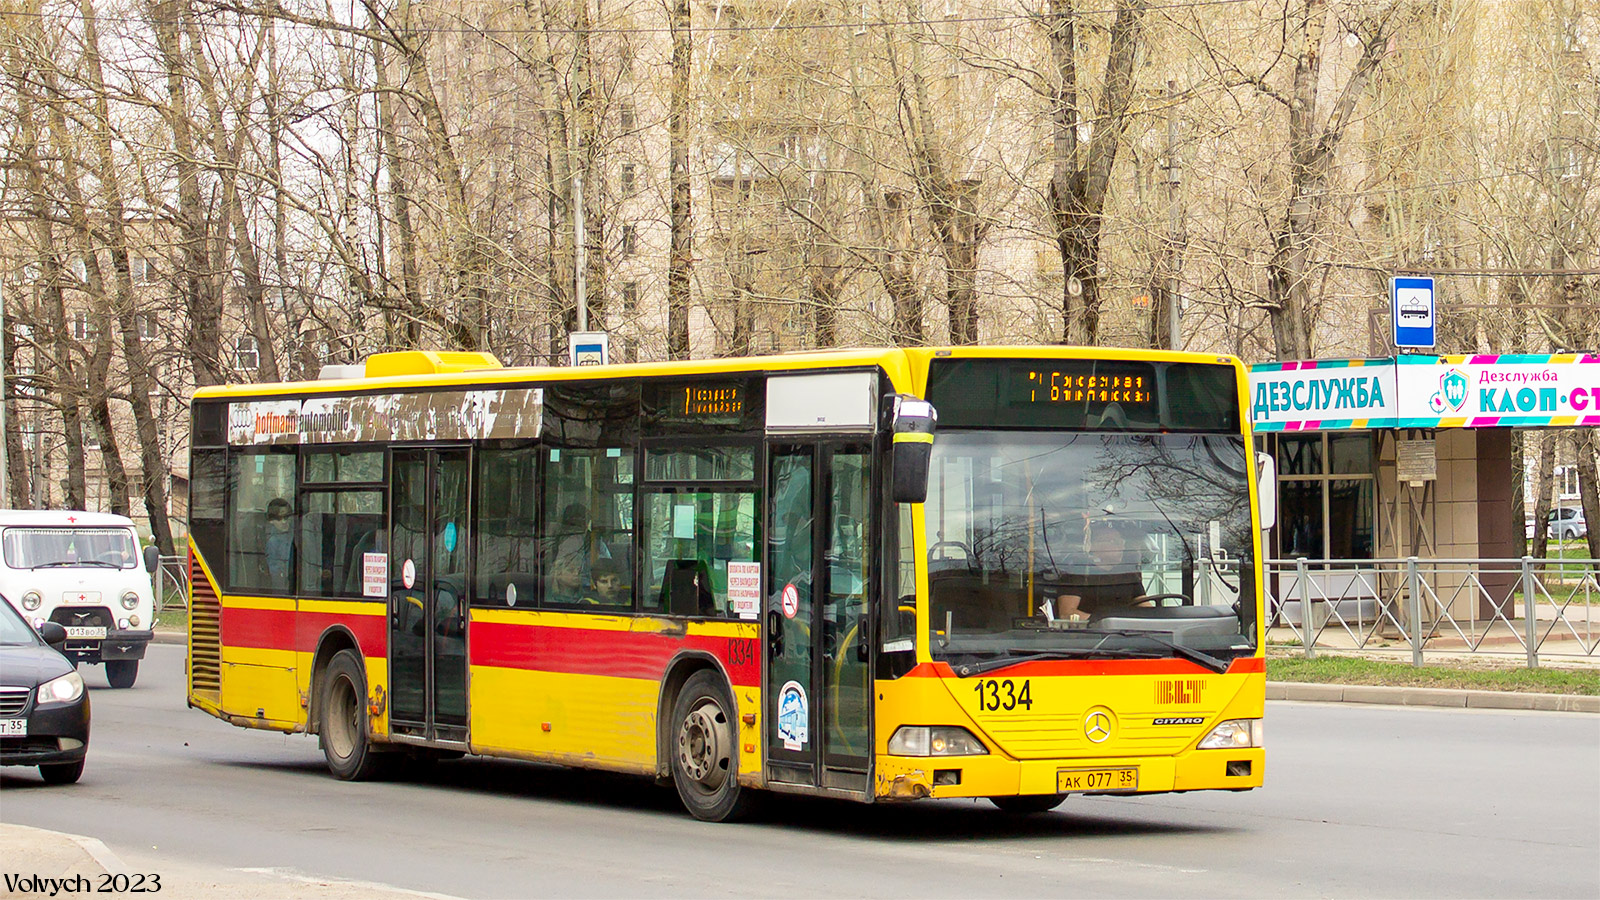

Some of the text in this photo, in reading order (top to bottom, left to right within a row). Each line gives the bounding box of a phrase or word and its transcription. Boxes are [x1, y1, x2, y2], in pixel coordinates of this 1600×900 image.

[1479, 369, 1558, 384] Дезслужба
[1253, 376, 1385, 420] ДЕЗСЛУЖБА
[256, 410, 297, 434] hoffmann
[299, 408, 349, 433] automobile
[728, 639, 754, 665] 1334
[974, 679, 1033, 711] 1334
[10, 720, 22, 730] 35
[1065, 771, 1132, 788] АК 077 35
